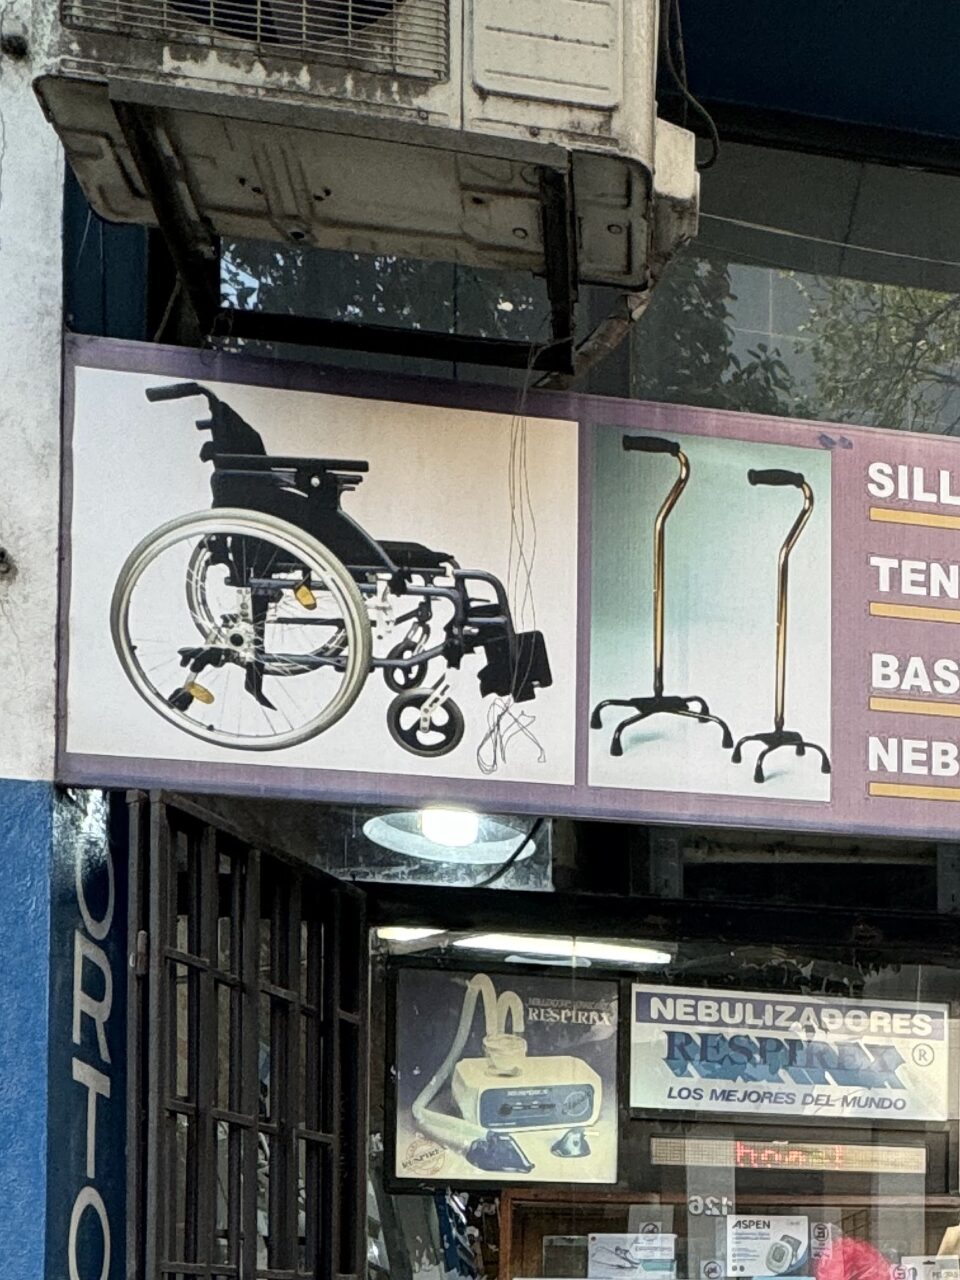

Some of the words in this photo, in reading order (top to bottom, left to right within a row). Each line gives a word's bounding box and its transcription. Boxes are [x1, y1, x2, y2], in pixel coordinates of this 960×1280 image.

[650, 997, 932, 1037] NEBULIZADORES
[663, 1031, 906, 1086] RESPIREX
[667, 1087, 704, 1101] LOS
[709, 1089, 796, 1106] MEJORES
[802, 1093, 834, 1107] DEL
[841, 1095, 906, 1111] MUNDO
[732, 1219, 771, 1229] ASPEN
